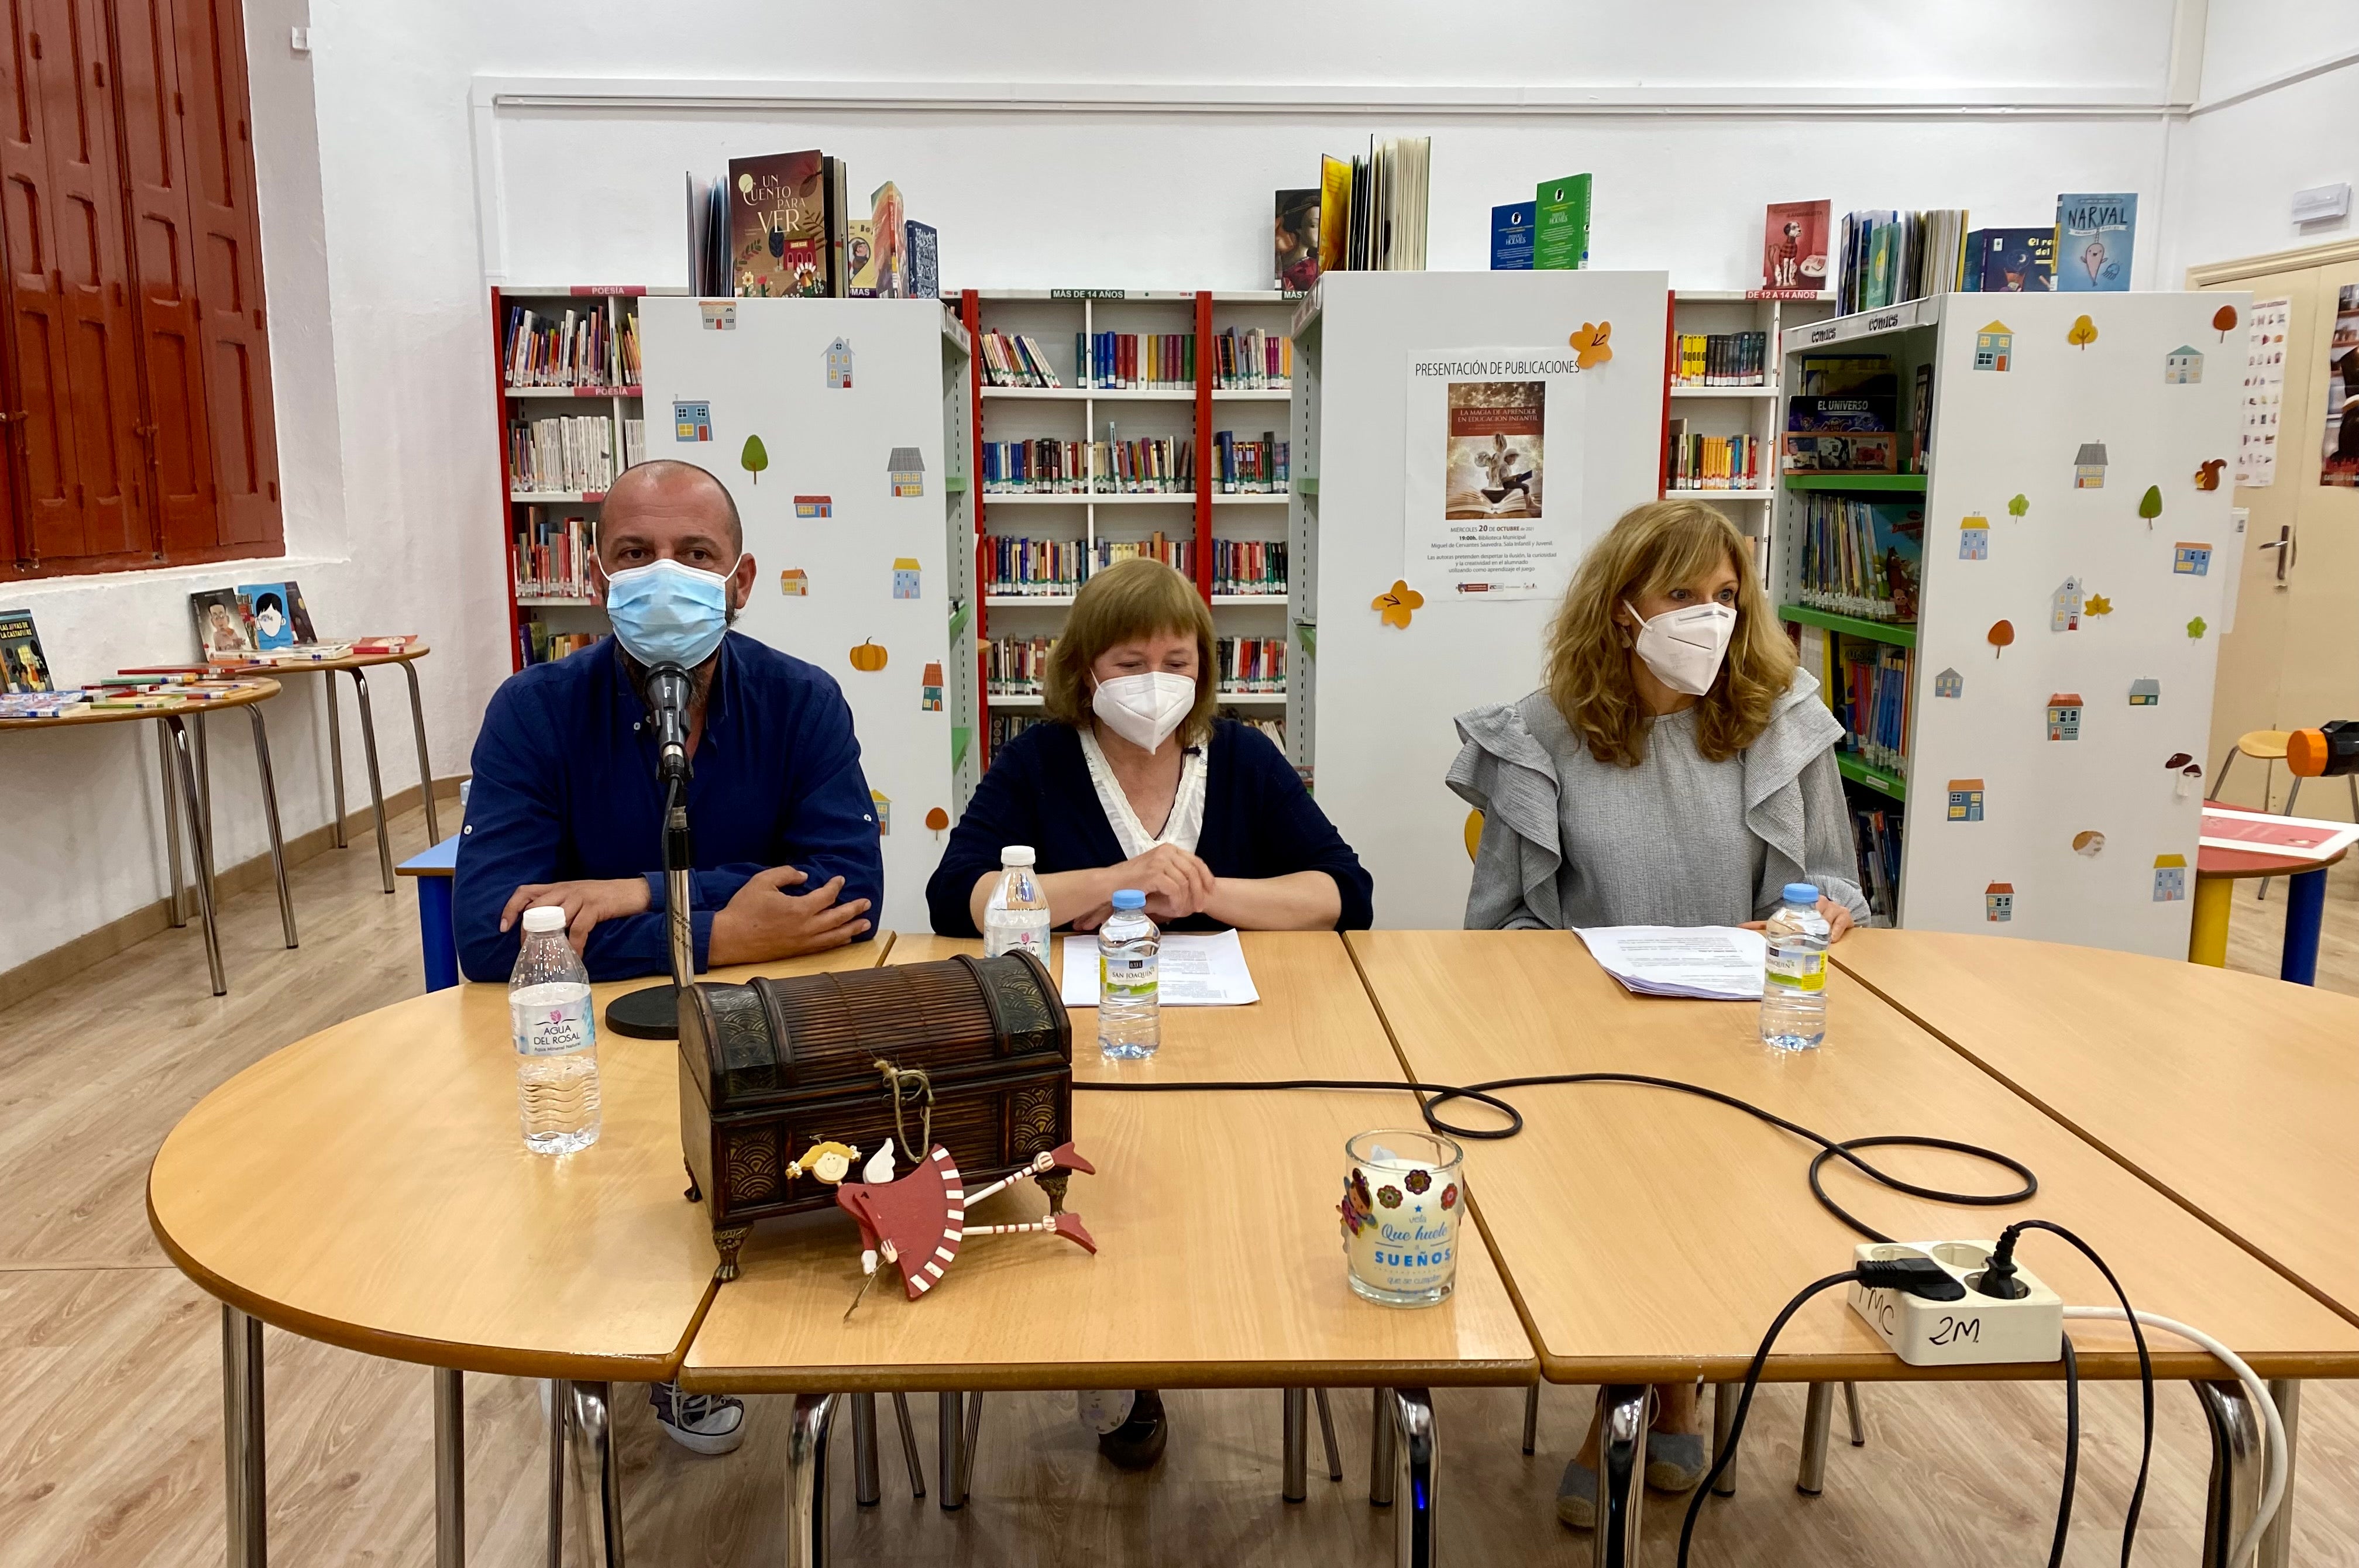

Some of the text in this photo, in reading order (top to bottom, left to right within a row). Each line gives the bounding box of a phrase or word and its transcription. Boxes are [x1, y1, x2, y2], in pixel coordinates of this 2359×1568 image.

[762, 174, 779, 187] UN
[742, 182, 791, 206] CUENTO
[777, 198, 806, 209] PARA
[757, 208, 800, 234] VER
[2068, 206, 2128, 228] NARVAL
[592, 286, 624, 294] POESÍA
[1053, 290, 1071, 298] MÁS
[1099, 289, 1123, 298] AÑOS
[1415, 360, 1580, 376] PRESENTACIÓN DE PUBLICACIONES
[595, 387, 628, 396] POESÍA
[1817, 400, 1868, 411] EL UNIVERSO
[544, 1025, 572, 1036] AGUA
[534, 1031, 581, 1045] DEL ROSAL
[566, 1041, 581, 1050] Natural
[1409, 1214, 1426, 1223] vela
[1381, 1222, 1447, 1242] Que huele
[1375, 1247, 1450, 1267] SUEÑOS
